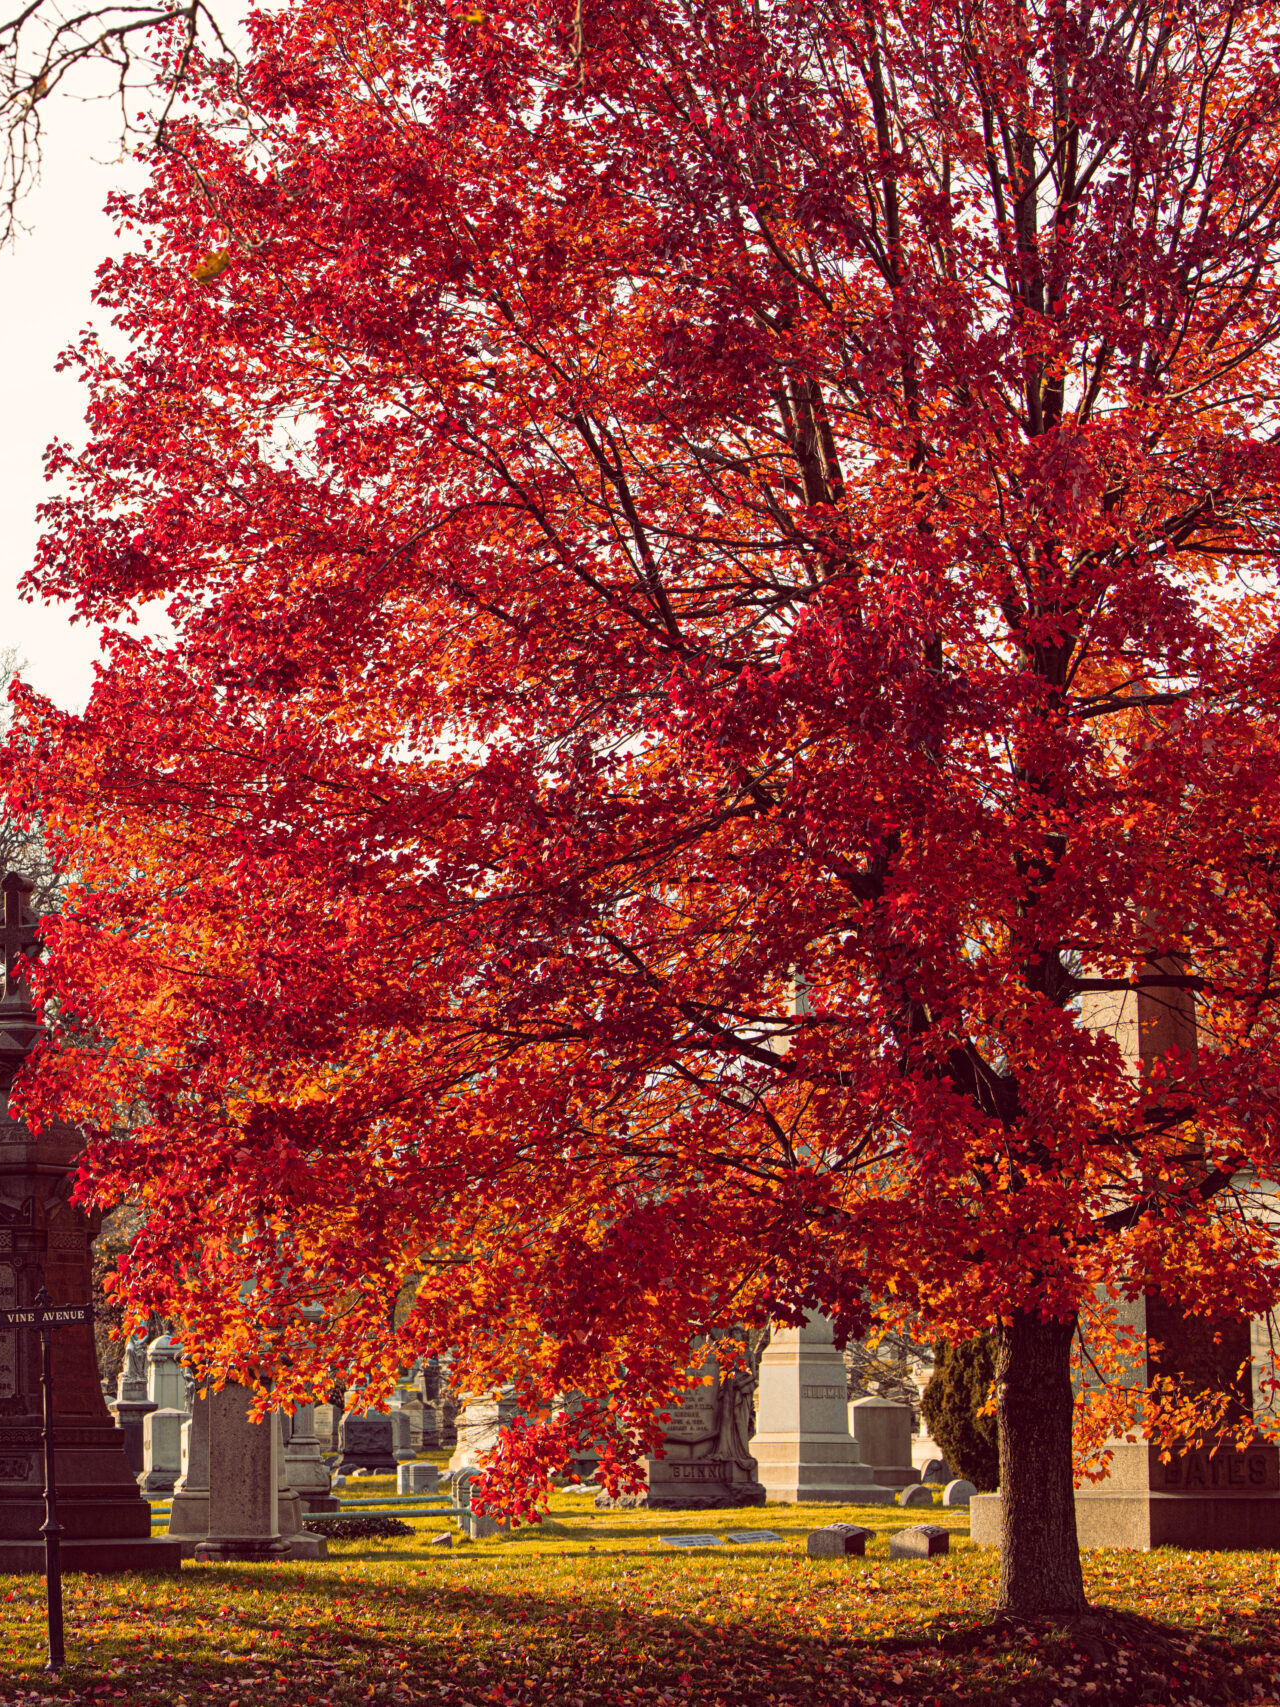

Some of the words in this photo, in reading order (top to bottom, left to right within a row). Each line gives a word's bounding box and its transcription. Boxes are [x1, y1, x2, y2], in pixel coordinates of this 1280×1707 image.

[7, 1313, 35, 1323] VINE
[42, 1310, 85, 1321] AVENUE
[673, 1465, 721, 1478] BLINN
[1164, 1454, 1267, 1484] BATES
